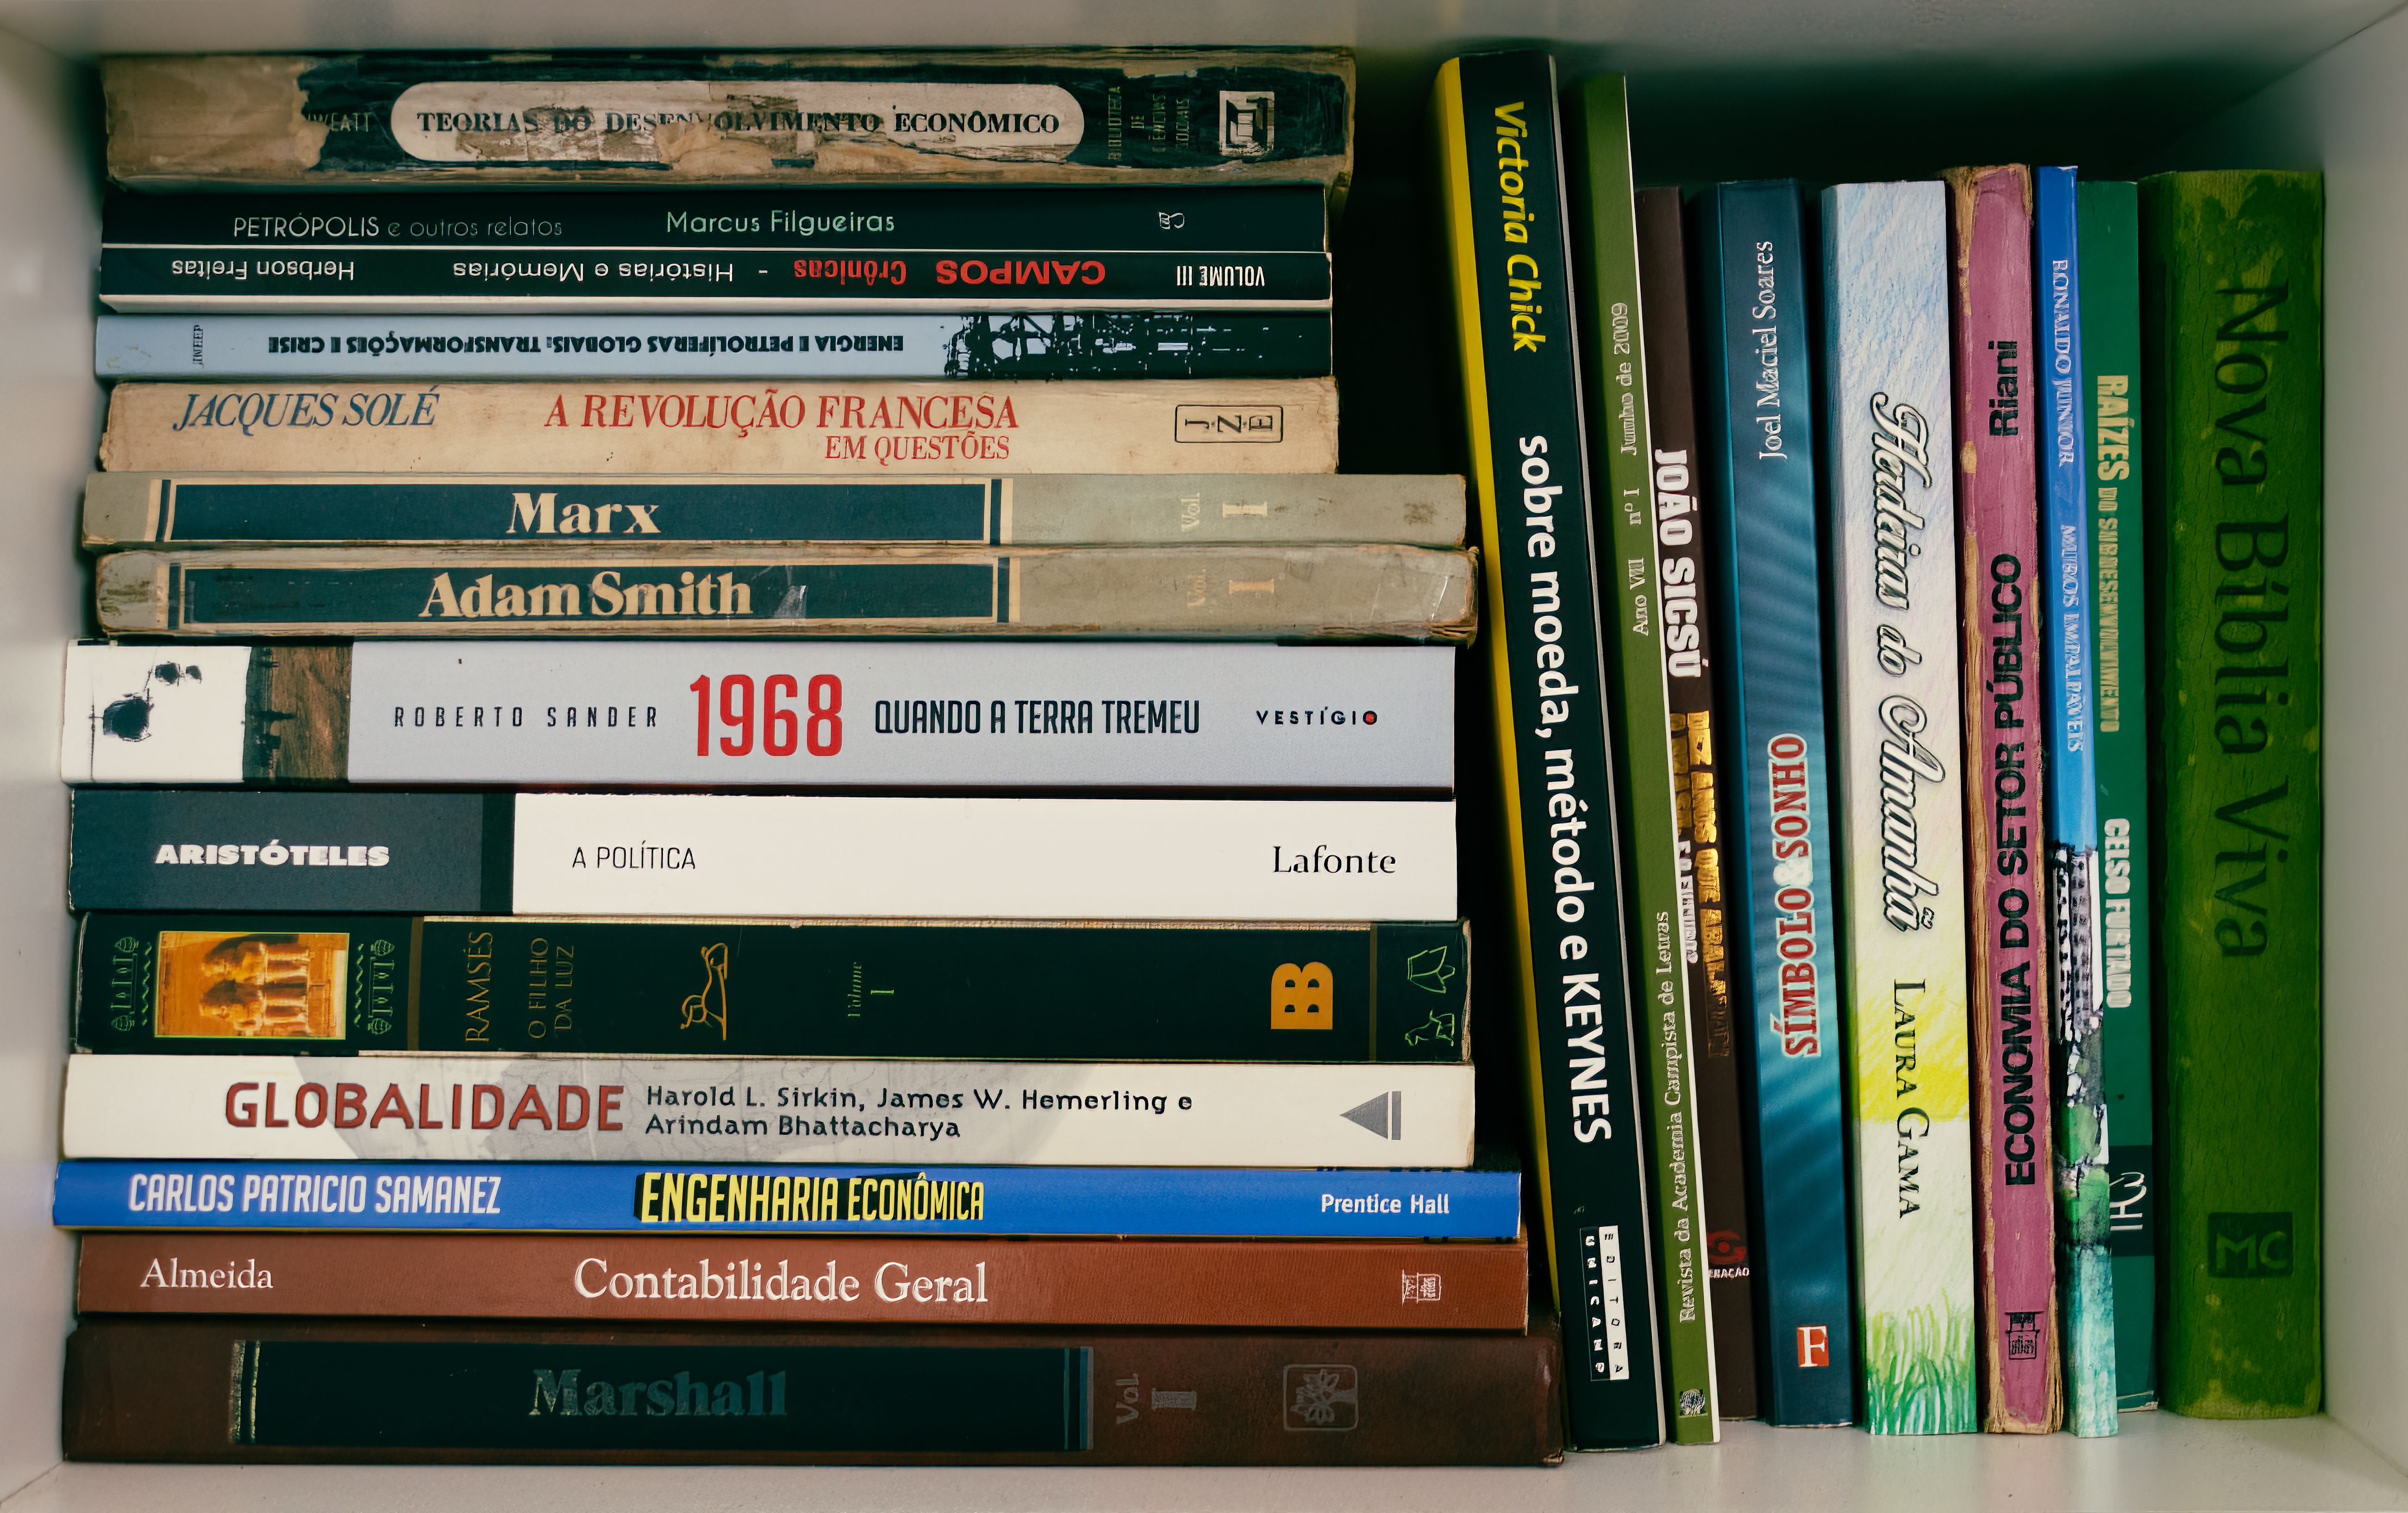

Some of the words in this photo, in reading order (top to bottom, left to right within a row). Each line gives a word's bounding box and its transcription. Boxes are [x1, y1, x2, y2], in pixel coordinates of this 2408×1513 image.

[417, 111, 539, 133] TEORIAS
[894, 110, 1059, 133] ECONÔMICO
[1494, 101, 1530, 243] Victoria
[233, 215, 379, 238] PETRÓPOLIS
[388, 223, 400, 237] e
[410, 217, 478, 237] outros
[488, 216, 561, 235] relatos
[668, 211, 759, 232] Marcus
[772, 210, 894, 236] Filgueiras
[172, 260, 247, 280] Freitas
[257, 261, 353, 280] Herbson
[454, 263, 583, 282] Memórias
[595, 264, 608, 280] e
[619, 263, 732, 282] Histórias
[794, 260, 906, 285] Crônicas
[936, 260, 1105, 285] CAMPOS
[1177, 266, 1192, 286] III
[1199, 266, 1265, 286] VOLUME
[1752, 241, 1776, 319] Soares
[1507, 254, 1545, 352] Chick
[269, 337, 325, 353] CRISE
[347, 331, 541, 356] TRANSFORMAÇÕES
[647, 336, 793, 356] PETROLÍFERAS
[815, 336, 903, 352] ENERGIA
[1612, 303, 1630, 355] 2009
[1616, 362, 1632, 386] de
[1752, 325, 1780, 407] Maciel
[1988, 341, 2018, 436] Riani
[2215, 286, 2288, 486] Nova
[174, 393, 334, 435] JACQUES
[342, 386, 440, 426] SOLÉ
[544, 394, 568, 426] A
[581, 387, 805, 438] REVOLUÇÃO
[817, 395, 1018, 429] FRANCESA
[1619, 392, 1637, 456] Junho
[2098, 375, 2134, 481] RAÍZES
[825, 436, 867, 459] EM
[875, 431, 1009, 466] QUESTÕES
[1759, 413, 1787, 460] Joel
[506, 493, 661, 533] Marx
[1519, 436, 1563, 557] sobre
[1655, 449, 1697, 545] JOÃO
[1870, 392, 1932, 610] Herdeiras
[2098, 487, 2118, 511] DO
[419, 572, 582, 618] Adam
[591, 571, 753, 615] Smith
[1633, 595, 1649, 636] Ano
[1662, 557, 1708, 677] SICSÚ
[1531, 571, 1578, 738] moeda,
[1877, 624, 1922, 677] do
[1986, 554, 2024, 729] PÚBLICO
[2215, 522, 2289, 753] Bíblia
[395, 707, 522, 727] ROBERTO
[548, 707, 656, 727] SANDER
[690, 674, 842, 756] 1968
[876, 700, 980, 734] QUANDO
[991, 700, 1005, 733] A
[1015, 700, 1092, 734] TERRA
[1102, 700, 1199, 734] TREMEU
[1256, 707, 1377, 725] VESTÍGIO
[1768, 733, 1812, 859] SONHO
[1878, 695, 1946, 932] Amanhã
[1994, 741, 2028, 876] SETOR
[155, 839, 389, 866] ARISTÓTELES
[573, 847, 586, 868] A
[598, 840, 695, 869] POLÍTICA
[1544, 747, 1590, 924] método
[2104, 818, 2130, 894] CELSO
[1273, 845, 1395, 874] Lafonte
[2214, 783, 2289, 958] Viva
[2001, 890, 2029, 949] DO
[555, 946, 574, 987] LUZ
[1560, 936, 1588, 960] e
[1656, 912, 1671, 975] Letras
[2105, 899, 2131, 1008] FURTADO
[463, 932, 493, 1041] RAMSÉS
[529, 938, 548, 1008] FILHO
[1658, 981, 1674, 1005] de
[1771, 886, 1821, 1057] SÍMBOLO
[529, 1020, 546, 1038] O
[555, 999, 572, 1029] DA
[1563, 973, 1611, 1143] KEYNES
[1662, 1011, 1682, 1105] Campista
[1894, 979, 1925, 1100] LAURA
[2000, 961, 2035, 1185] ECONOMIA
[226, 1083, 624, 1131] GLOBALIDADE
[648, 1086, 735, 1106] Harold
[747, 1087, 765, 1107] L.
[778, 1087, 864, 1112] Sirkin,
[877, 1088, 963, 1108] James
[974, 1089, 1010, 1109] W.
[1023, 1089, 1167, 1114] Hemerling
[1179, 1096, 1191, 1110] e
[645, 1114, 767, 1135] Arindam
[779, 1115, 960, 1141] Bhattacharya
[1667, 1111, 1688, 1211] Academia
[1897, 1107, 1929, 1219] GAMA
[130, 1174, 234, 1211] CARLOS
[243, 1175, 366, 1212] PATRICIO
[375, 1176, 501, 1214] SAMANEZ
[641, 1172, 839, 1222] ENGENHARIA
[847, 1171, 984, 1222] ECONÔMICA
[1322, 1194, 1401, 1213] Prentice
[1411, 1194, 1449, 1214] Hall
[1674, 1218, 1689, 1241] da
[2216, 1231, 2288, 1272] MC
[140, 1258, 273, 1288] Almeida
[574, 1258, 859, 1301] Contabilidade
[875, 1261, 988, 1302] Geral
[1677, 1248, 1695, 1323] Revista
[528, 1369, 787, 1417] Marshall
